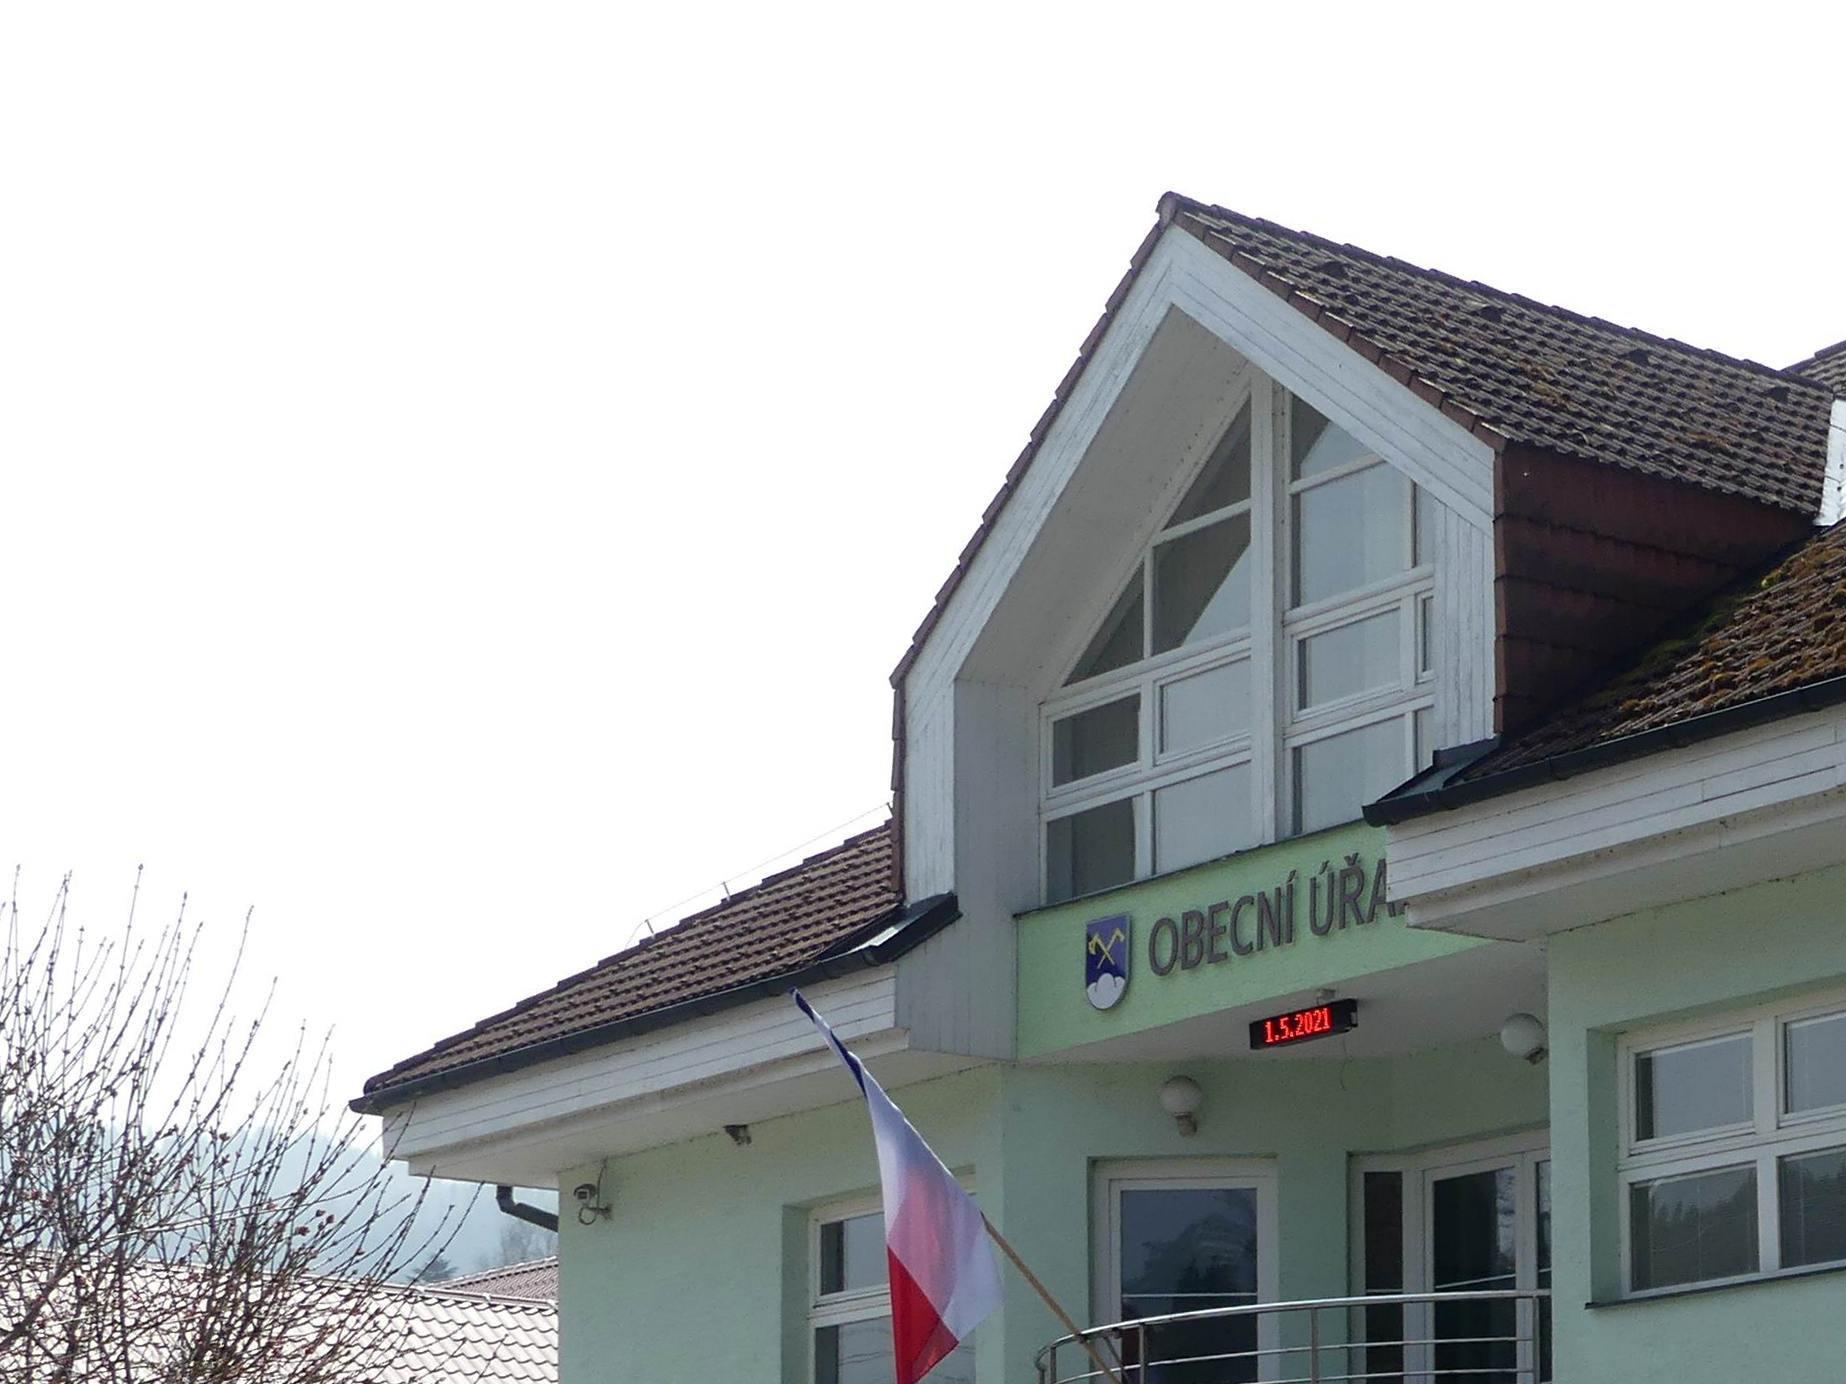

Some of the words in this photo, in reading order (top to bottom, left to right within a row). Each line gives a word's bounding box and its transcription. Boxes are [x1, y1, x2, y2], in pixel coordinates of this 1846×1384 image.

[1149, 869, 1297, 977] OBECNÍ
[1309, 852, 1405, 937] ÚŘA
[1264, 1007, 1330, 1043] 1.5.2021
